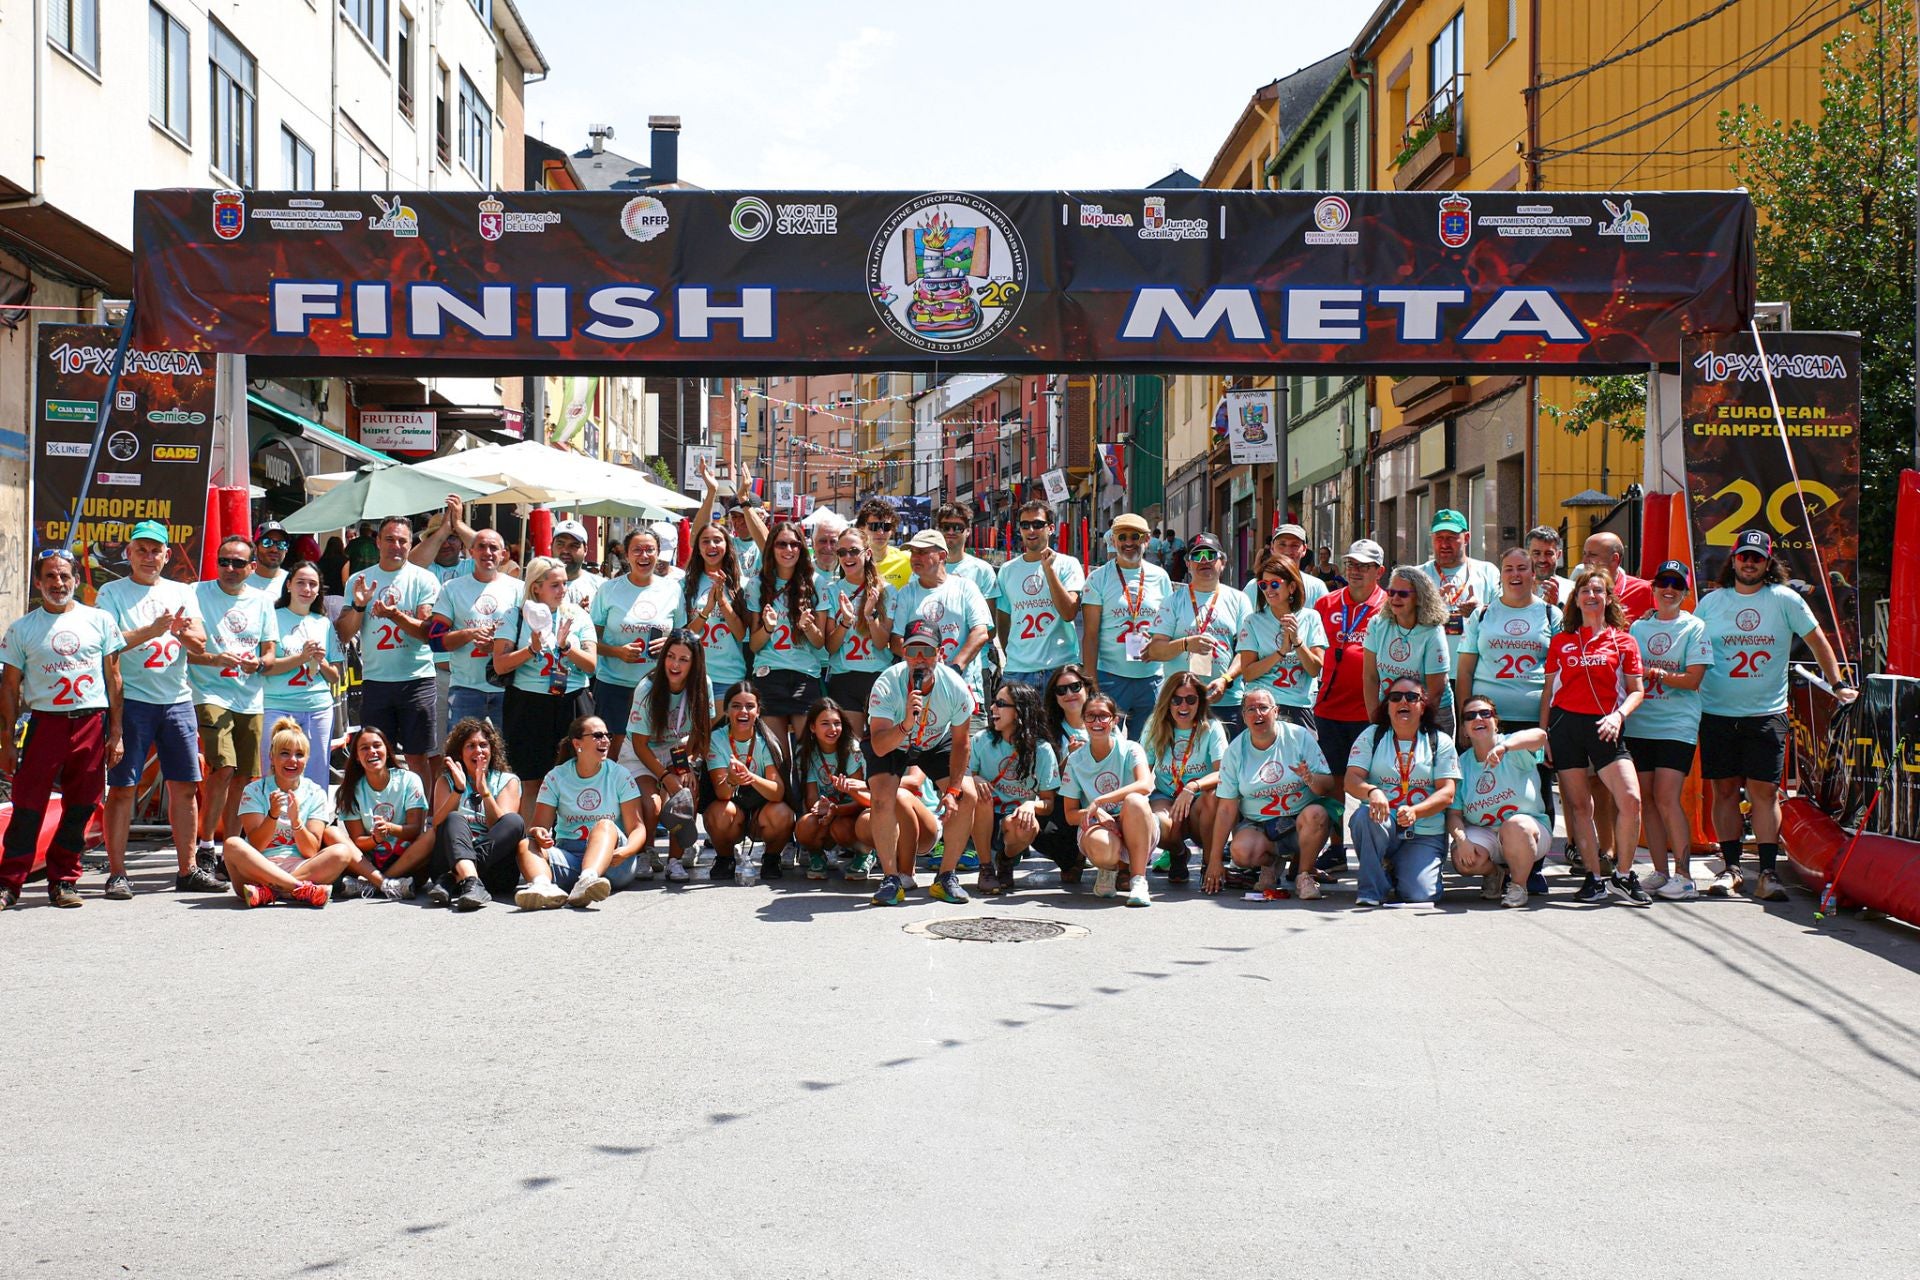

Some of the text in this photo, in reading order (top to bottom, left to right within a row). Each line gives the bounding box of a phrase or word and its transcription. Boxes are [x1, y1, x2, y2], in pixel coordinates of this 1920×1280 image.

[252, 211, 307, 219] AYUNTAMIENTO
[321, 212, 361, 220] VILLABLINO
[778, 205, 837, 218] WORLD
[1080, 206, 1103, 214] NOS
[506, 212, 560, 223] DIPUTACIÓN
[642, 215, 668, 225] RFEP
[1165, 218, 1208, 230] Junta de
[1479, 217, 1536, 225] AYUNTAMIENTO
[272, 221, 297, 229] VALLE
[310, 222, 342, 230] LACIANA
[506, 221, 544, 231] DE LEÓN
[777, 219, 837, 233] SKATE
[871, 195, 1024, 282] INLINE ALPINE EUROPEAN CHAMPIONSHIPS
[1139, 228, 1208, 240] Castilla y León
[272, 281, 773, 342] FINISH
[1121, 286, 1586, 340] META
[882, 309, 925, 346] VILLABLINO
[963, 327, 996, 348] AUGUST
[362, 412, 424, 424] FRUTERÍA
[506, 412, 520, 422] BAR
[1693, 424, 1853, 437] CHAMPIONSHIP
[155, 446, 198, 460] GADIS
[1018, 612, 1055, 639] 20
[1487, 639, 1543, 651] XAMASCADA
[1722, 635, 1775, 646] XAMASCADA
[143, 640, 182, 668] 20
[1495, 653, 1537, 679] 20
[1580, 659, 1608, 667] SKATE
[1729, 650, 1772, 677] 20
[1273, 666, 1305, 688] 20
[50, 674, 94, 705] 20
[1259, 791, 1302, 817] 20
[1465, 788, 1518, 814] XAMASCADA
